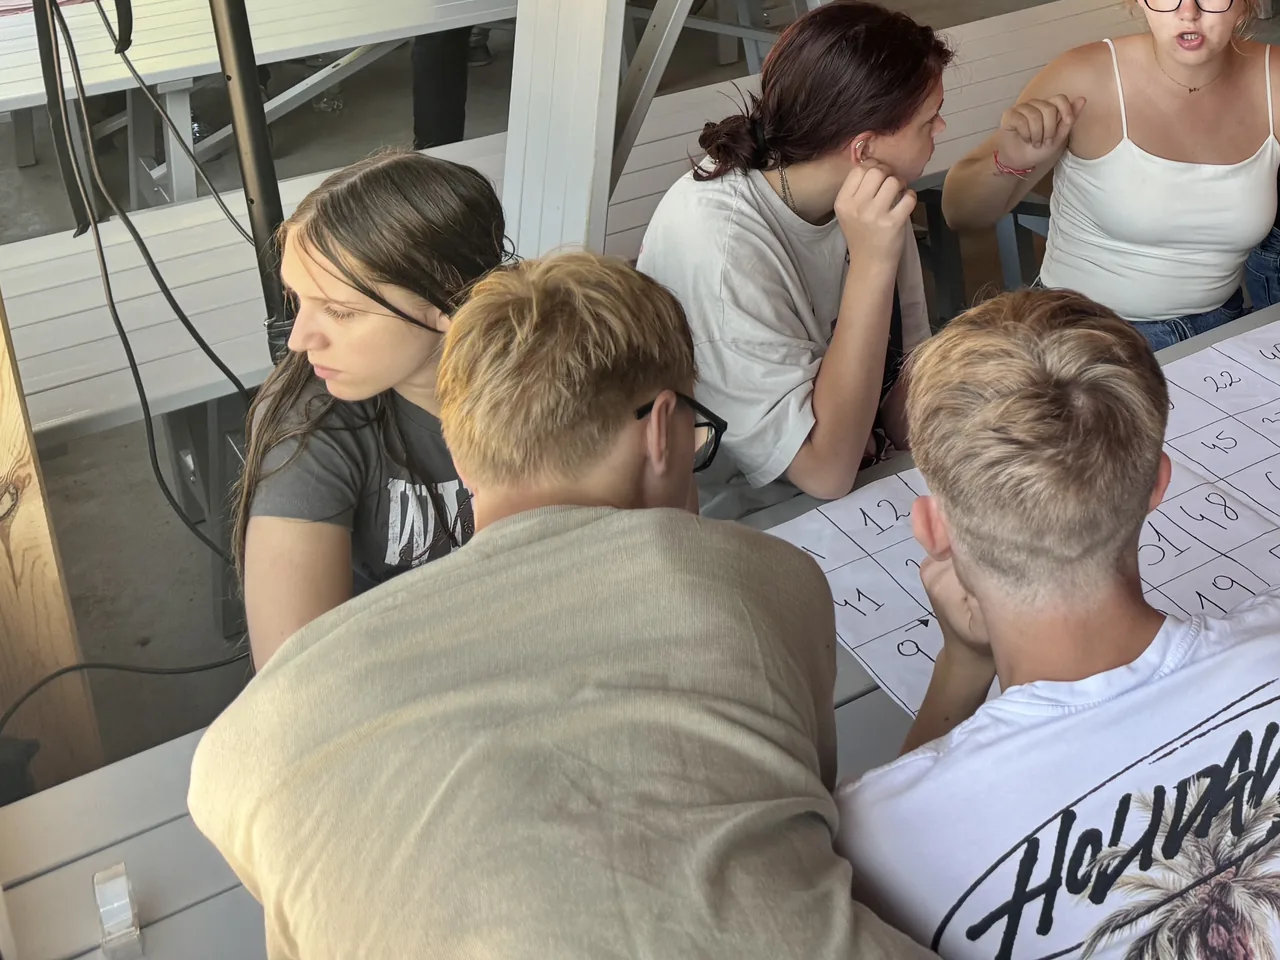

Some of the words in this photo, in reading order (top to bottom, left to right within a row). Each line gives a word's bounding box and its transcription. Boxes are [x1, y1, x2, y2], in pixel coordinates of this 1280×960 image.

[1203, 370, 1242, 393] 22
[1200, 430, 1238, 455] 45
[859, 498, 911, 536] 12
[1179, 492, 1239, 531] 48
